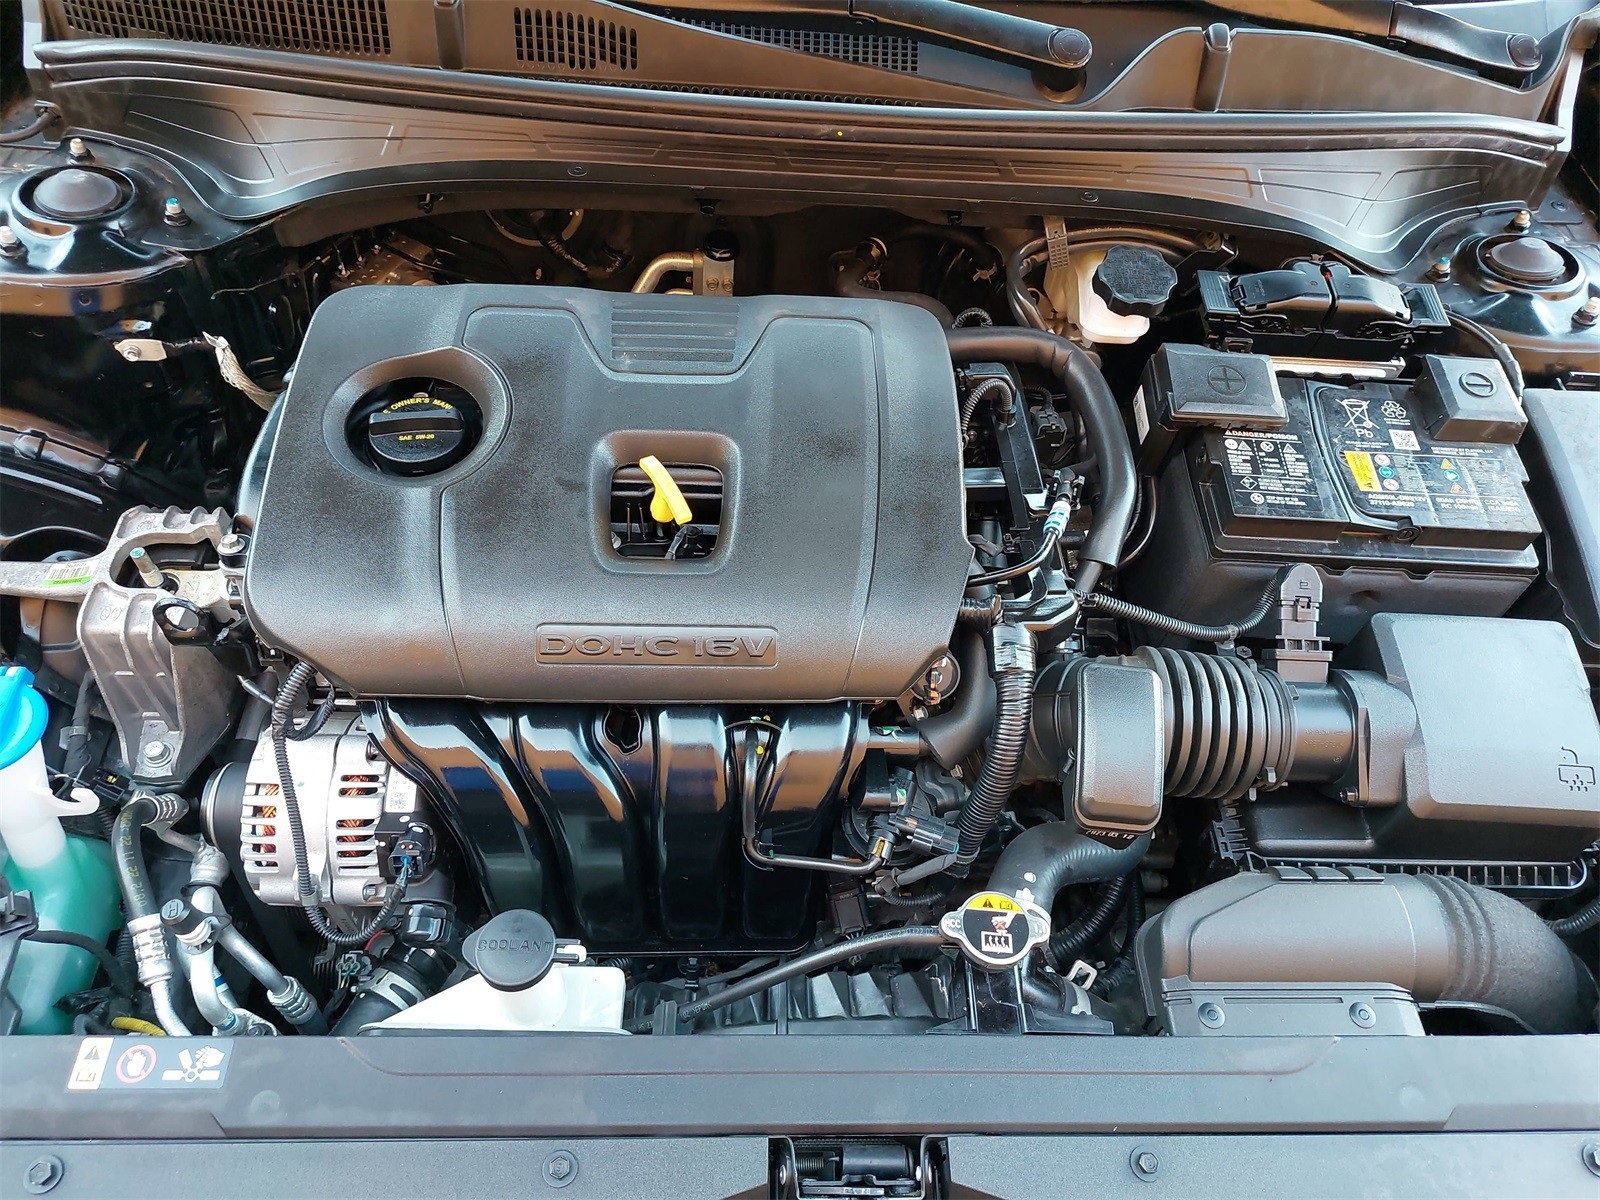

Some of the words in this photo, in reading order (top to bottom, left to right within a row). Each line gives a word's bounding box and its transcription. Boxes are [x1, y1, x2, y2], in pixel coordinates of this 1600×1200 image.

[390, 397, 430, 410] OWNER'S
[1231, 430, 1298, 440] DANGER/POISON
[1355, 428, 1374, 438] Pb
[539, 633, 679, 657] DOHC
[692, 635, 774, 658] 16V
[477, 939, 554, 952] COOLANT
